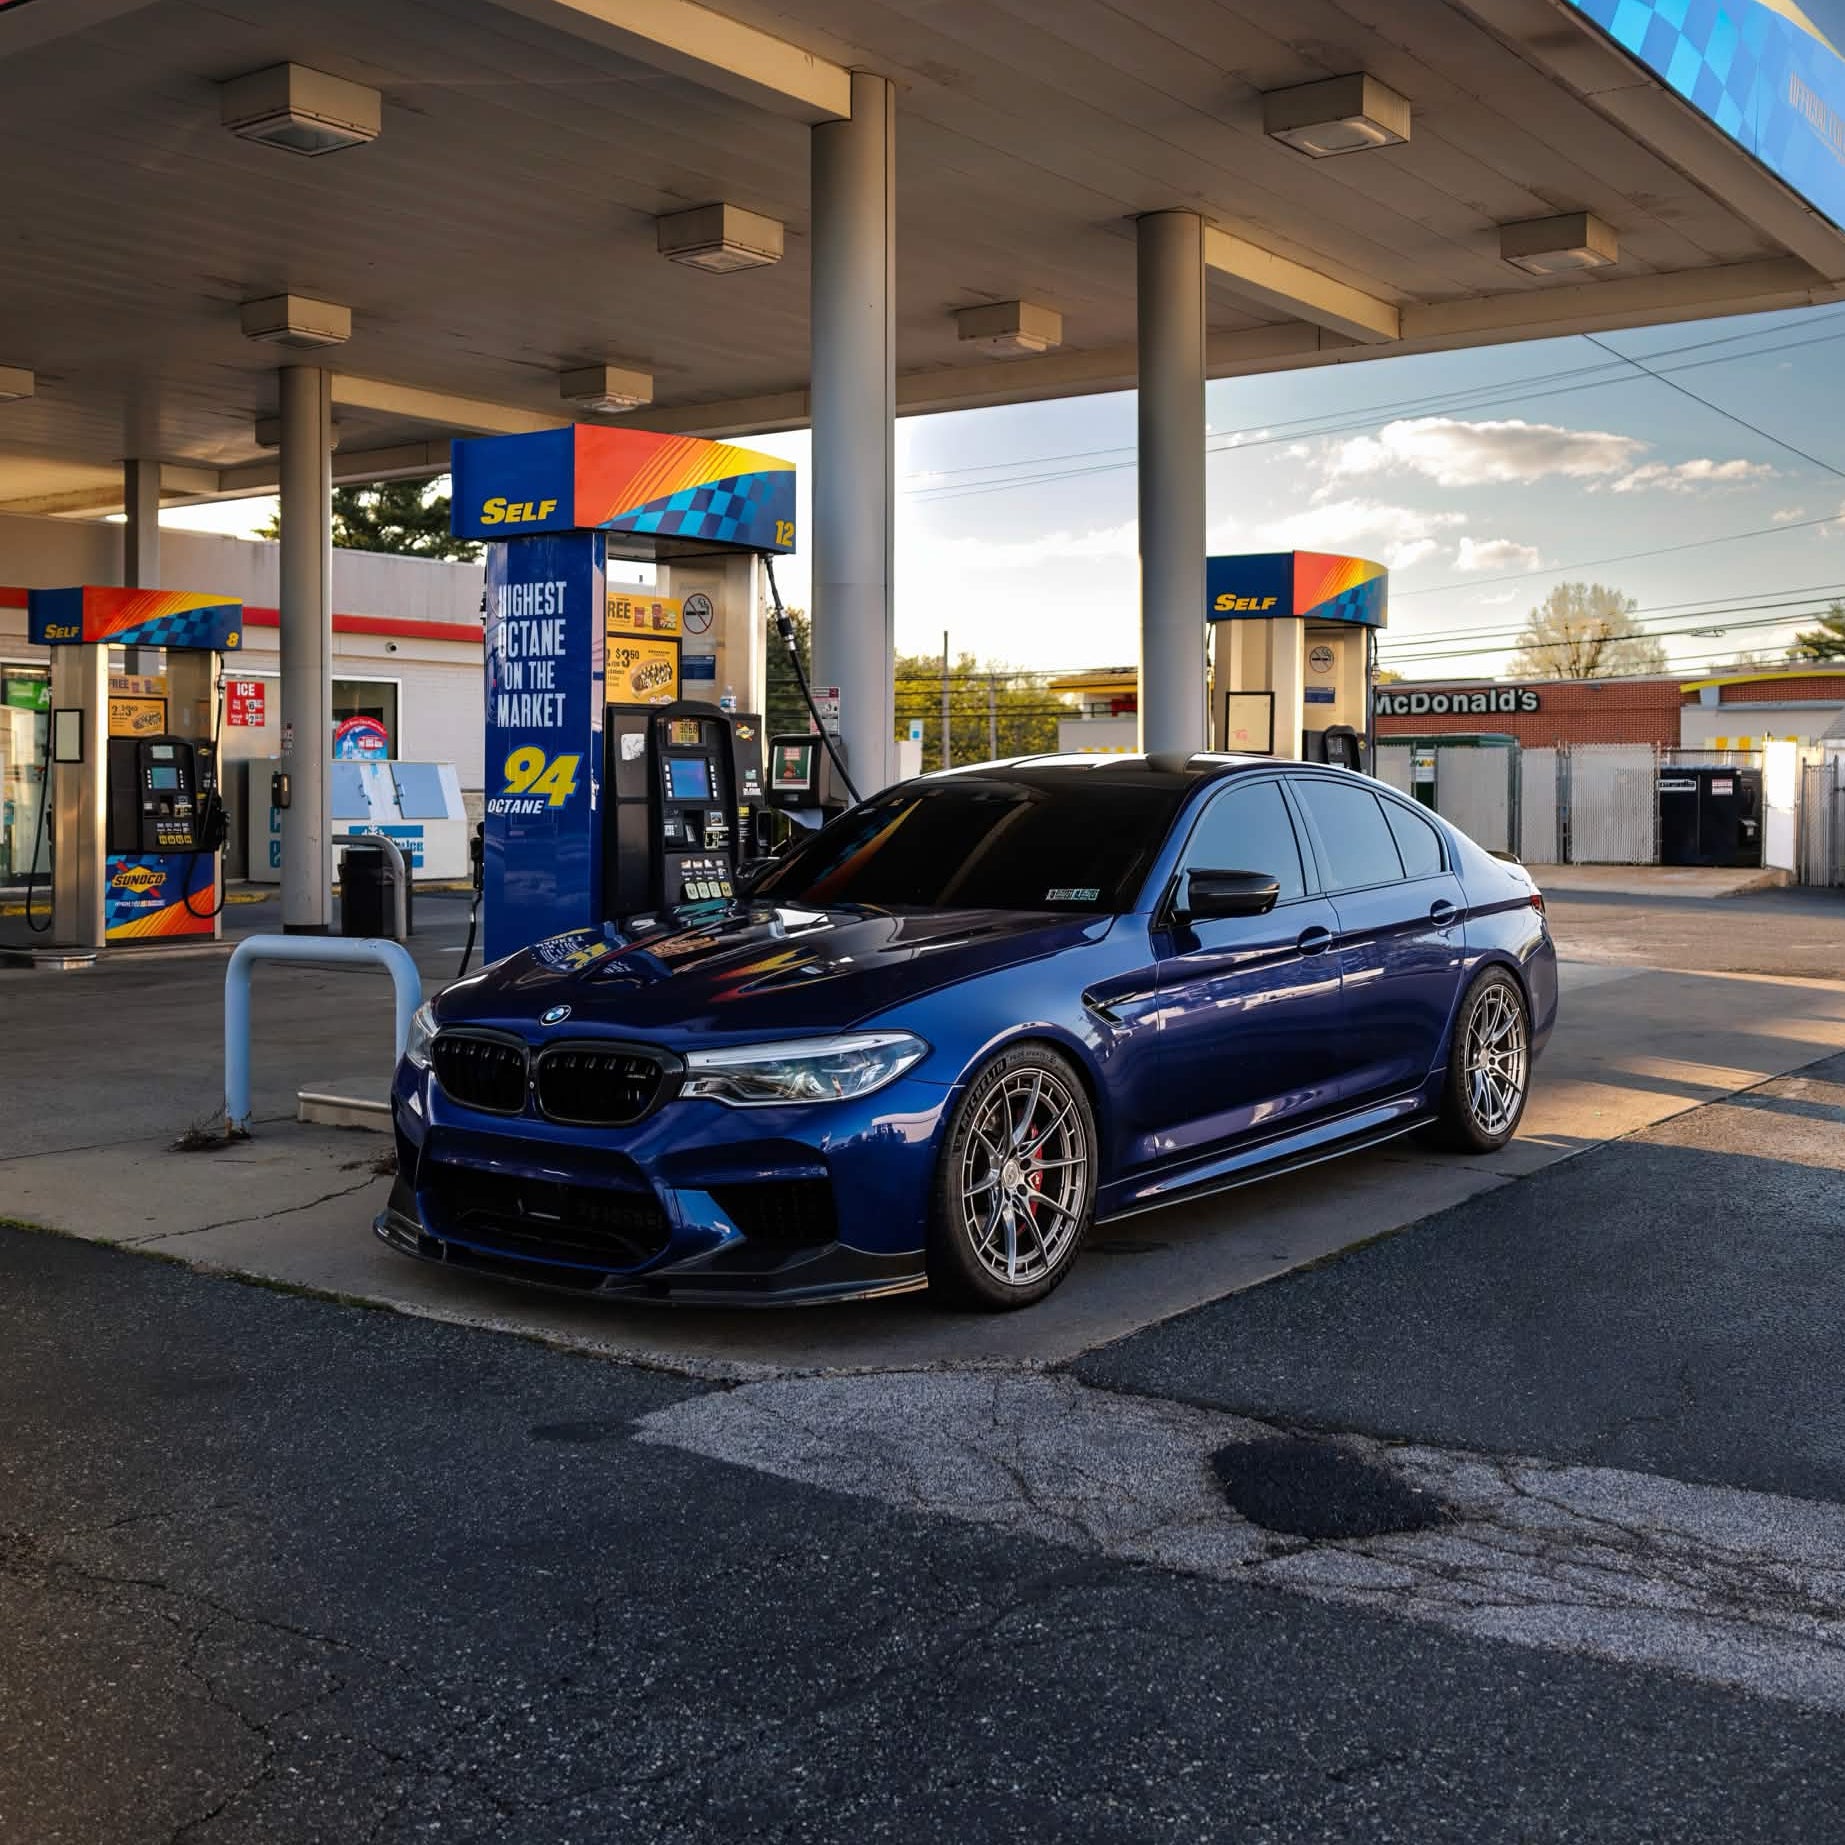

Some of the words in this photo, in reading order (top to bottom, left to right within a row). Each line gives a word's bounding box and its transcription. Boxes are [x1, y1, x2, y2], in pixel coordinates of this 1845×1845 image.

[480, 497, 557, 525] SELF
[775, 520, 795, 547] 12
[498, 581, 568, 617] HIGHEST
[606, 600, 632, 619] REE
[1213, 592, 1279, 612] SELF
[44, 623, 80, 640] SELF
[226, 631, 239, 647] 8
[497, 619, 566, 657] OCTANE
[504, 661, 523, 690] ON
[528, 660, 556, 689] THE
[236, 682, 256, 696] ICE
[1375, 688, 1539, 715] McDonald's
[497, 693, 566, 728] MARKET
[502, 745, 581, 808] 94
[488, 798, 545, 815] OCTANE
[114, 874, 164, 886] SUNOCO
